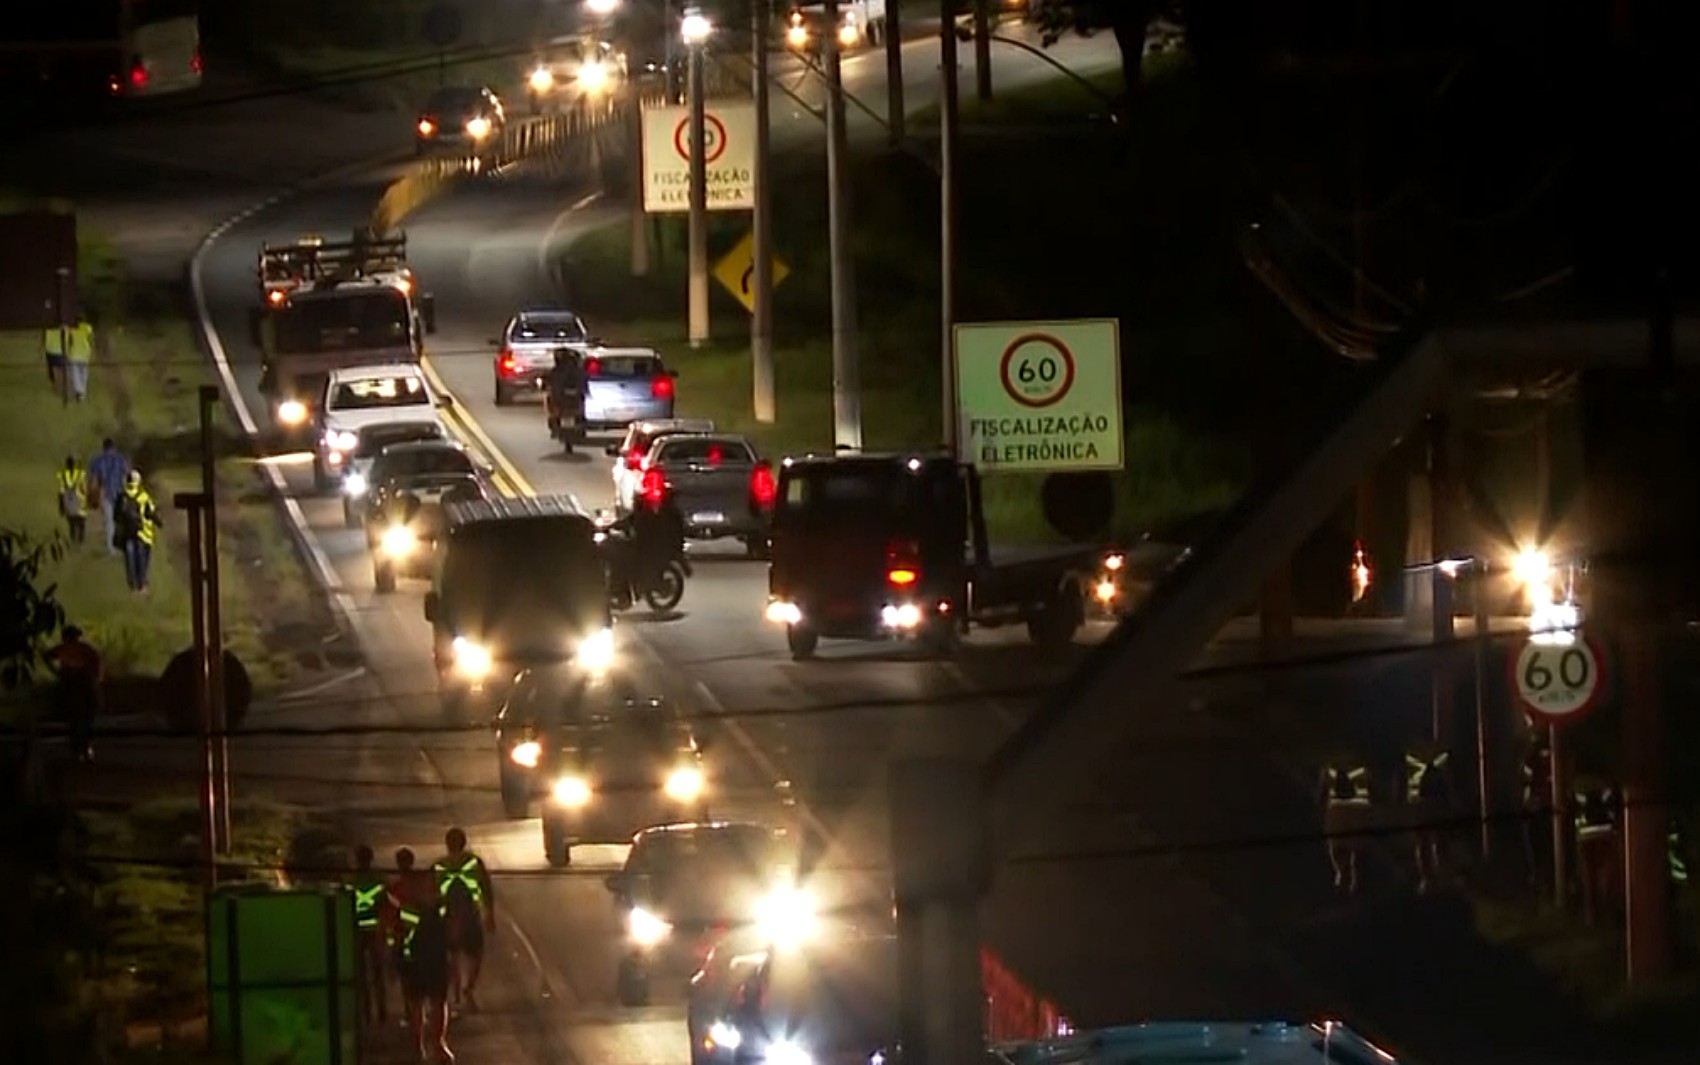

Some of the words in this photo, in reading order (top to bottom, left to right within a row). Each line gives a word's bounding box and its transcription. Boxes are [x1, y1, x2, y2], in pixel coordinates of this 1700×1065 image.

[1018, 357, 1057, 383] 60
[970, 412, 1109, 438] FISCALIZAÇÃO
[981, 437, 1099, 463] ELETRÔNICA
[1524, 648, 1589, 691] 60
